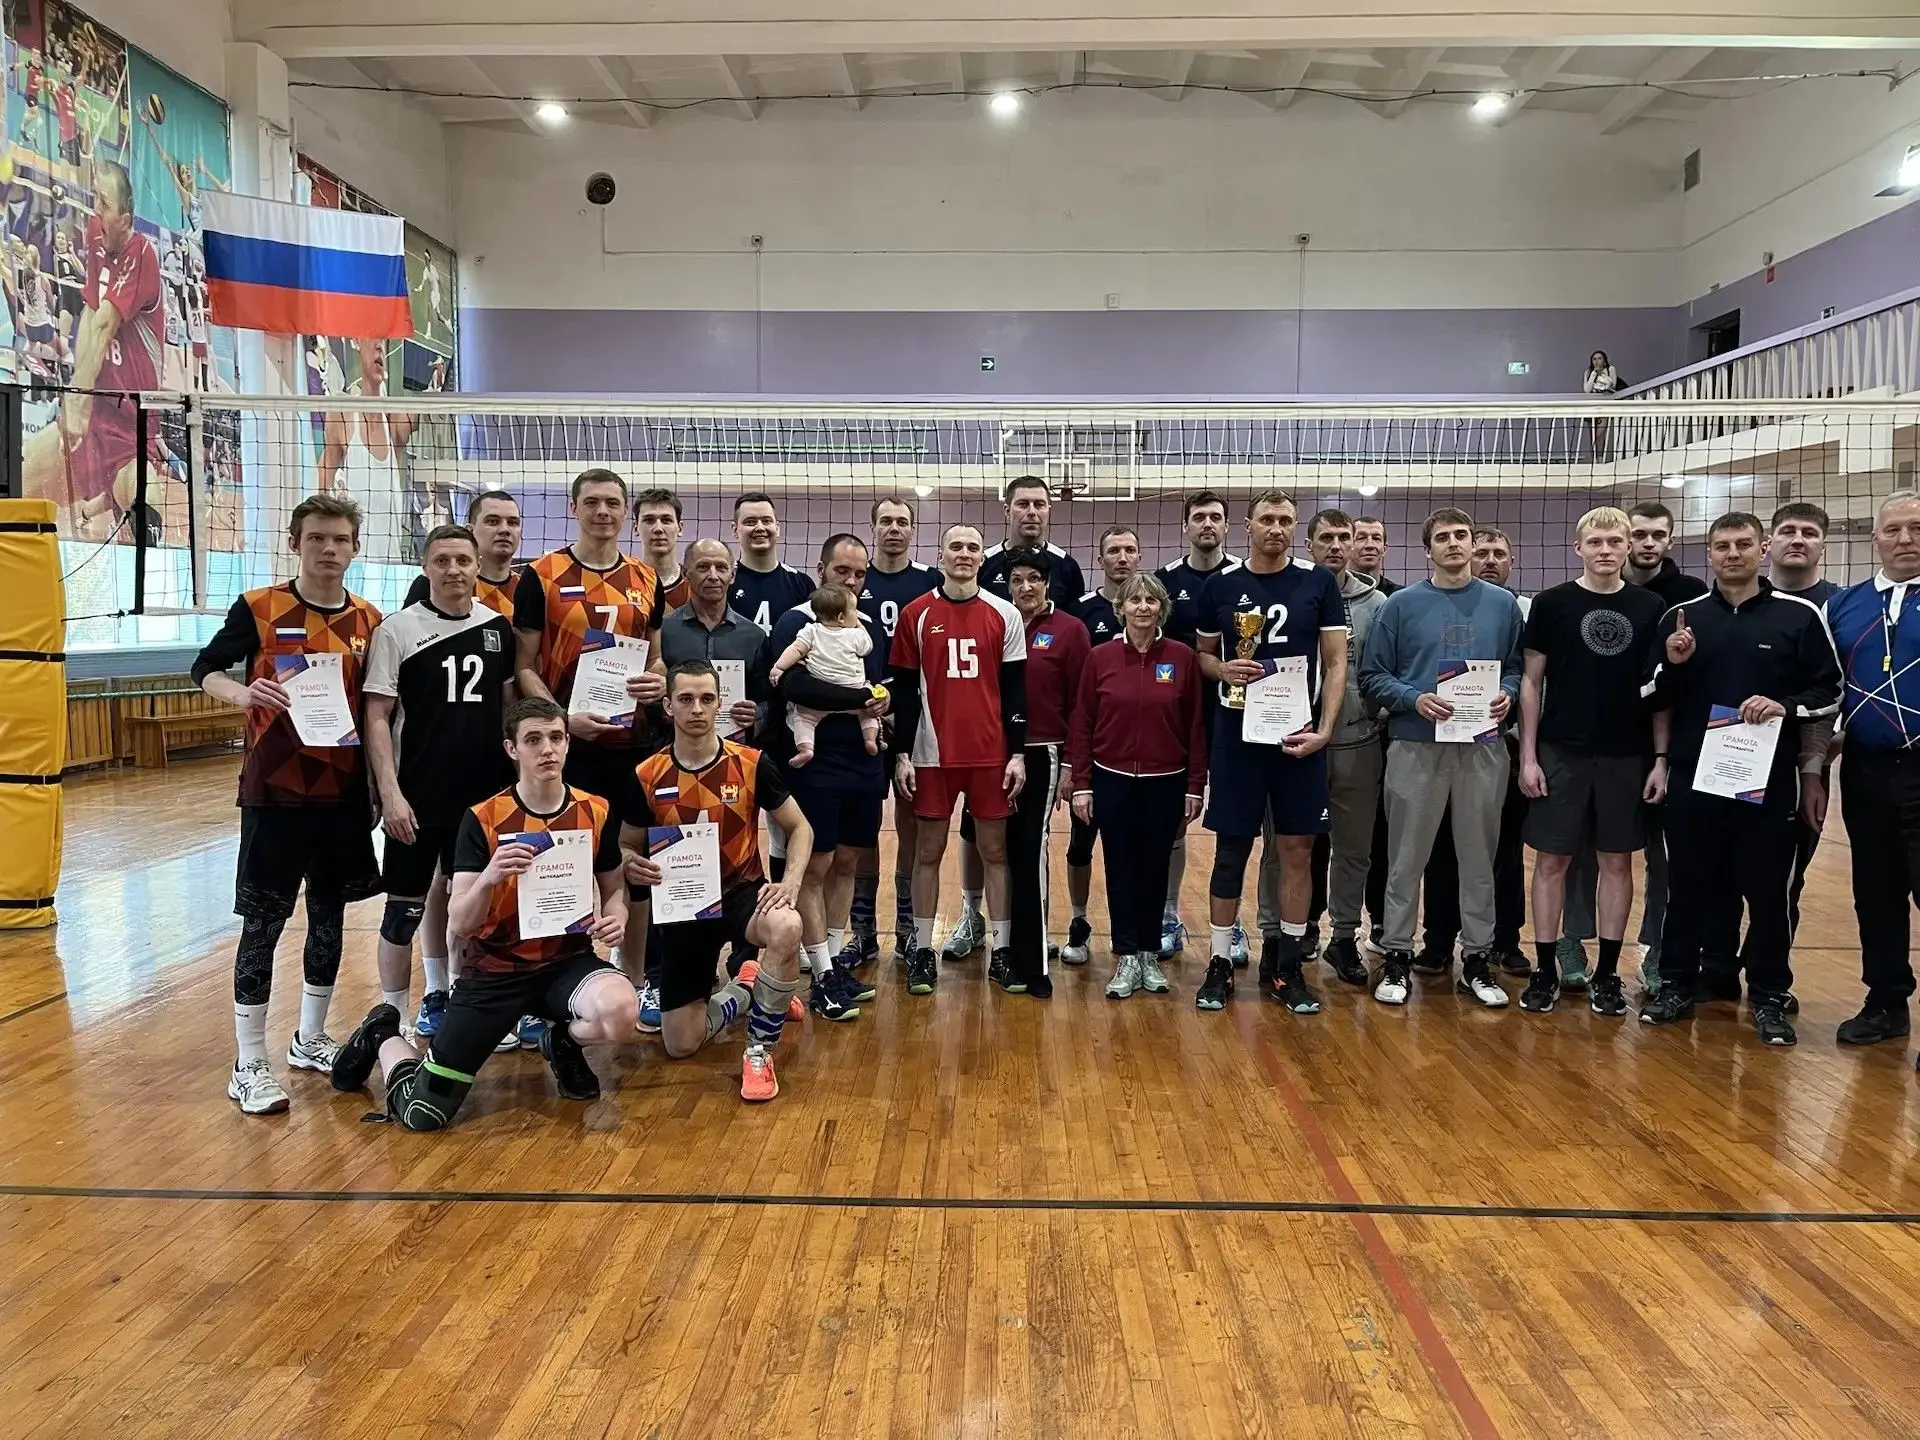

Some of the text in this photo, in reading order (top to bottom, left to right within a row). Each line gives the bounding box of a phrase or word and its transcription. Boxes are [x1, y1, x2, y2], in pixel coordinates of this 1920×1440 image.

[595, 605, 618, 634] 7
[754, 600, 773, 637] 4
[880, 600, 898, 637] 9
[594, 658, 628, 671] ГРАМОТА
[946, 637, 979, 679] 15
[442, 654, 484, 702] 12
[295, 683, 330, 693] ГРАМОТА
[1261, 685, 1292, 694] ГРАМОТА
[1452, 685, 1485, 693] ГРАМОТА
[1721, 734, 1758, 747] ГРАМОТА
[666, 854, 703, 864] ГРАМОТА
[535, 863, 575, 873] ГРАМОТА
